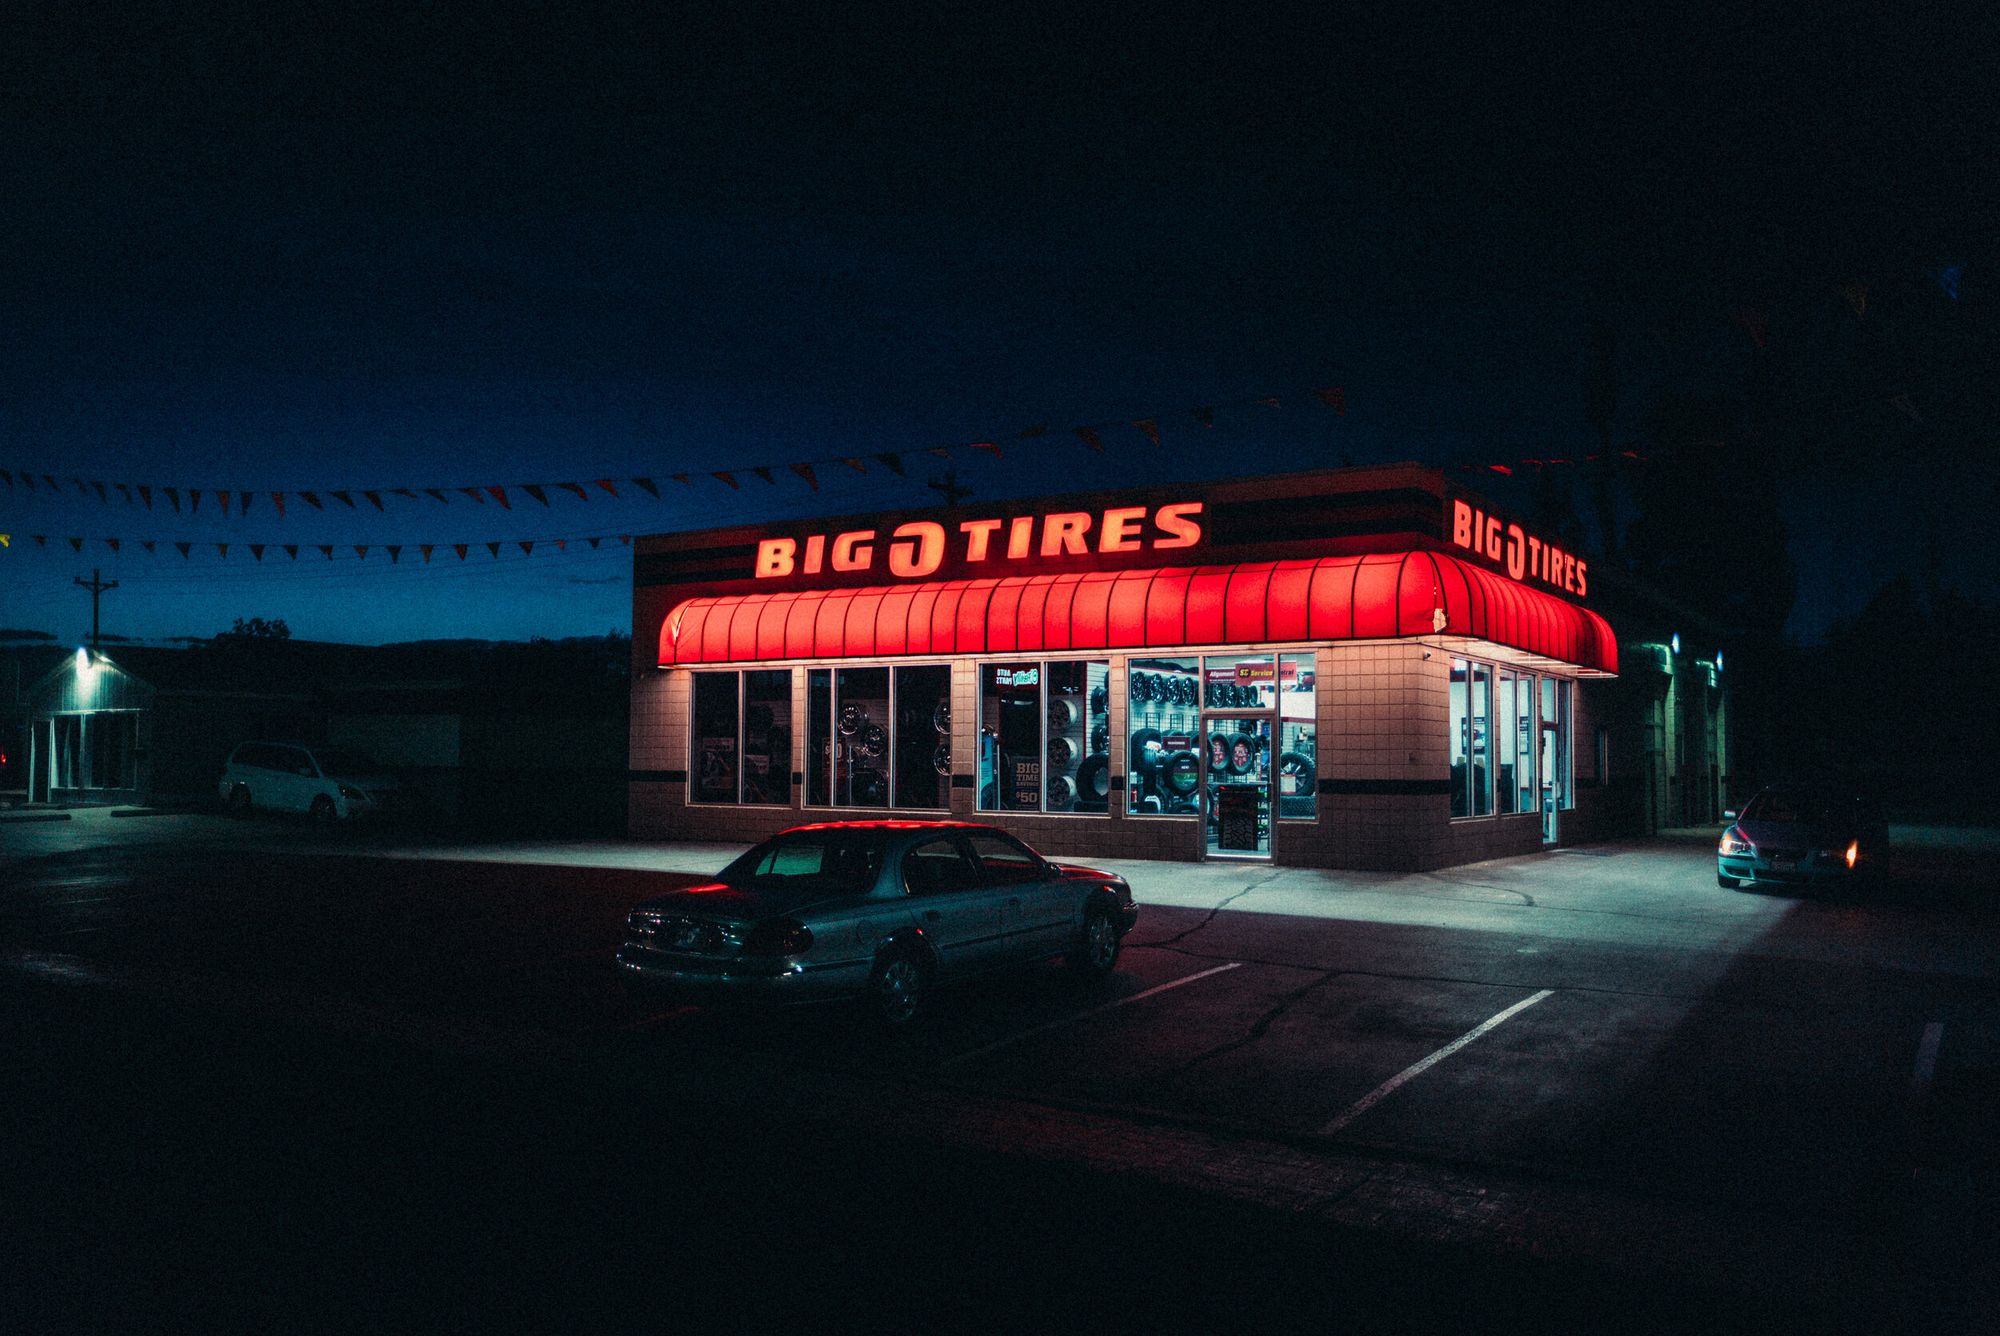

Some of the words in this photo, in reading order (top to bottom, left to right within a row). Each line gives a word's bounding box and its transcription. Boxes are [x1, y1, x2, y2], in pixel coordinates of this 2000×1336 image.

[755, 530, 875, 579] BIG
[889, 521, 946, 577] O
[959, 502, 1203, 562] TIRES
[1453, 498, 1502, 562] BIG
[1507, 523, 1525, 580] O
[1528, 535, 1587, 597] TIRES
[1016, 762, 1039, 773] BIG
